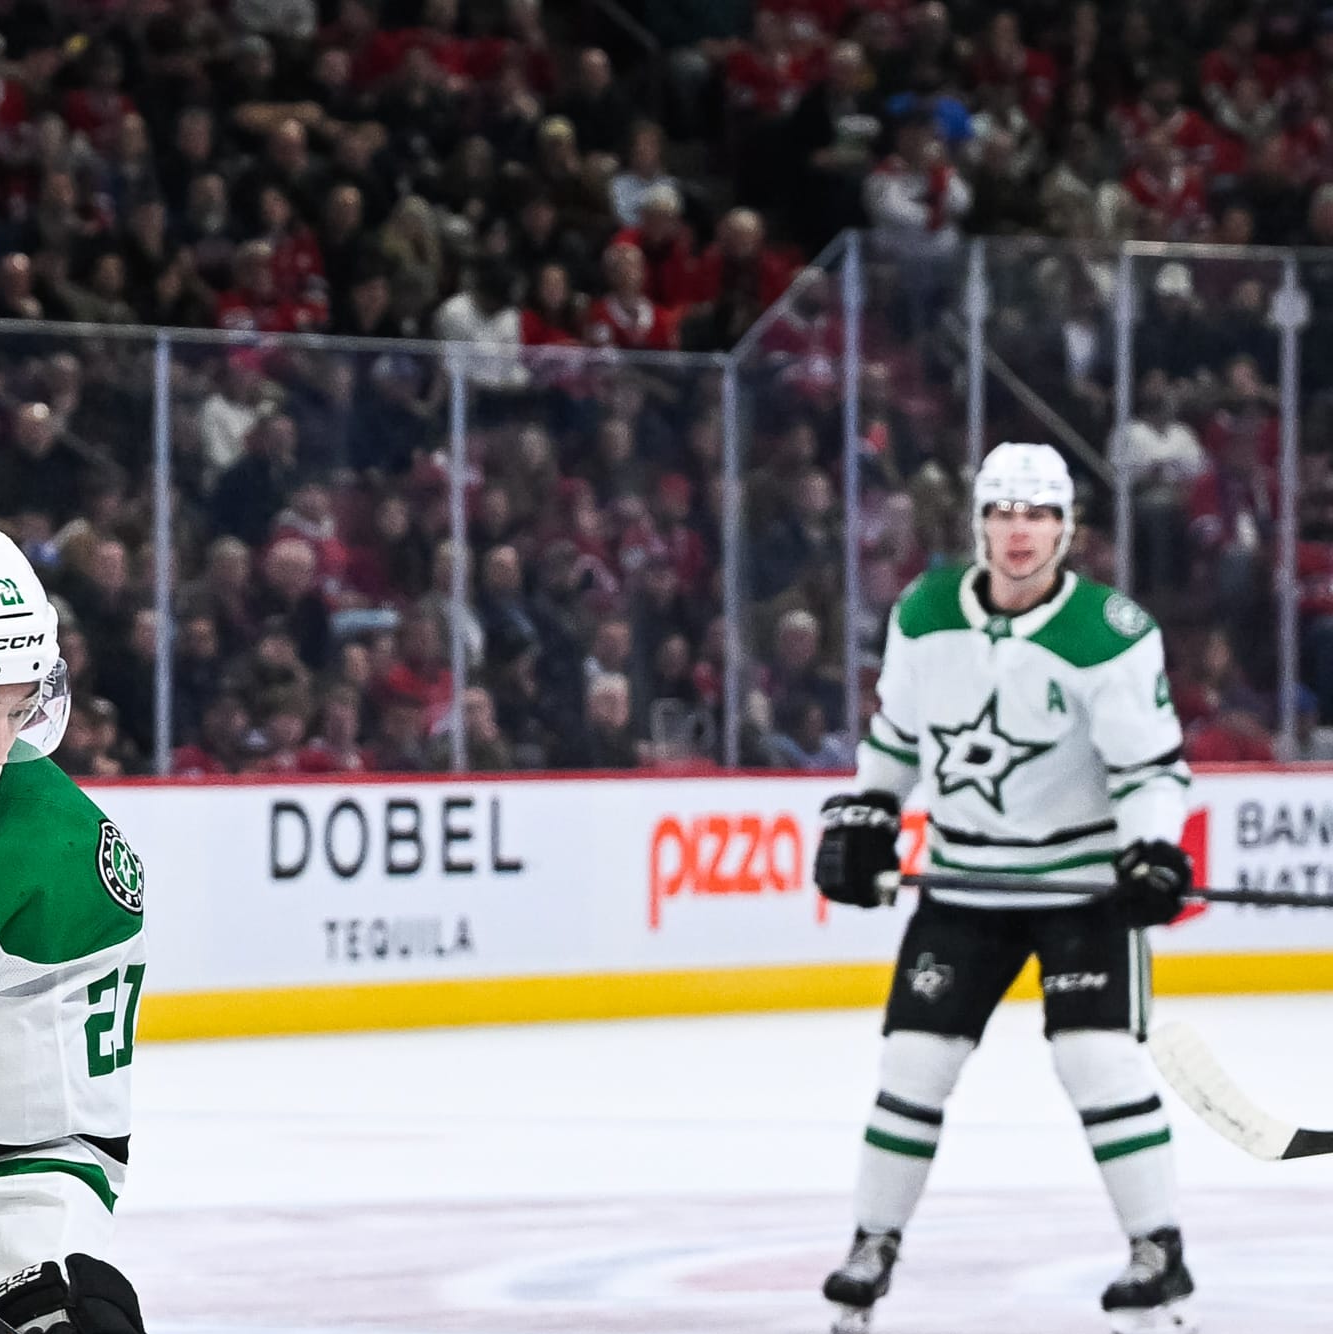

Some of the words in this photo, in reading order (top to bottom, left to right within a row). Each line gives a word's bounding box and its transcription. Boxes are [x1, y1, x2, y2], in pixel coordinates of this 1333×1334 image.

[269, 796, 526, 880] DOBEL
[648, 812, 806, 930] pizza
[84, 963, 146, 1078] 21
